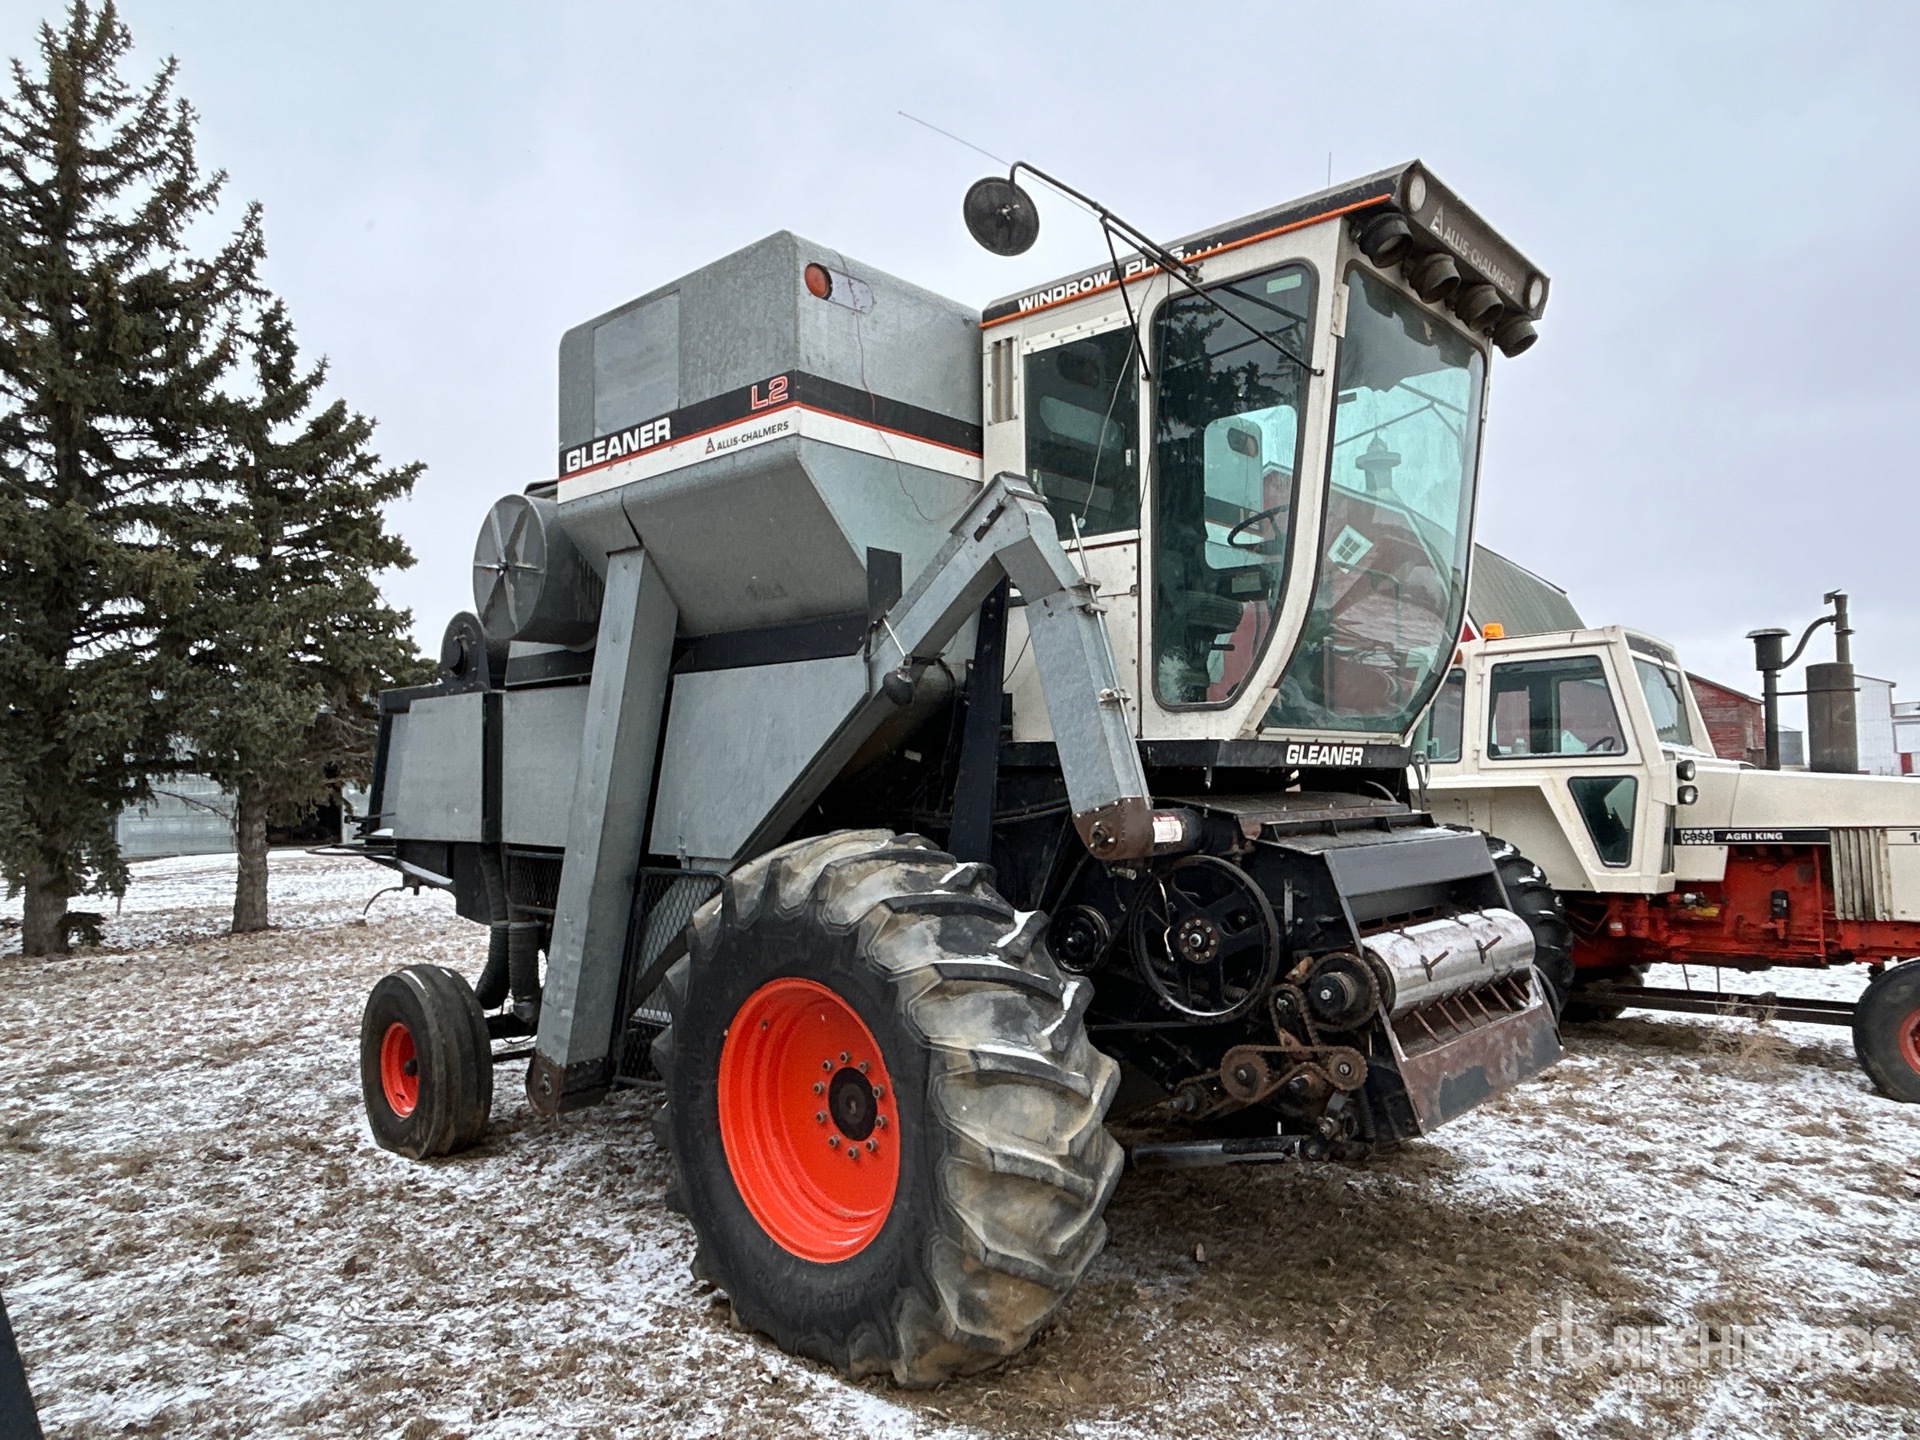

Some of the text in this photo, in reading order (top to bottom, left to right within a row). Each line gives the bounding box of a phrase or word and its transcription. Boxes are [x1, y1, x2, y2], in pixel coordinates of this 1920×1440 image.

[1443, 227, 1516, 295] ALLIS-CHALMERS
[1017, 270, 1112, 312] WINDROW
[751, 375, 789, 411] L2
[565, 417, 671, 473] GLEANER
[716, 420, 789, 451] ALLIS-CHALMERS
[1286, 744, 1364, 766] GLEANER
[1725, 832, 1752, 841] AGRI
[1755, 832, 1784, 841] KING
